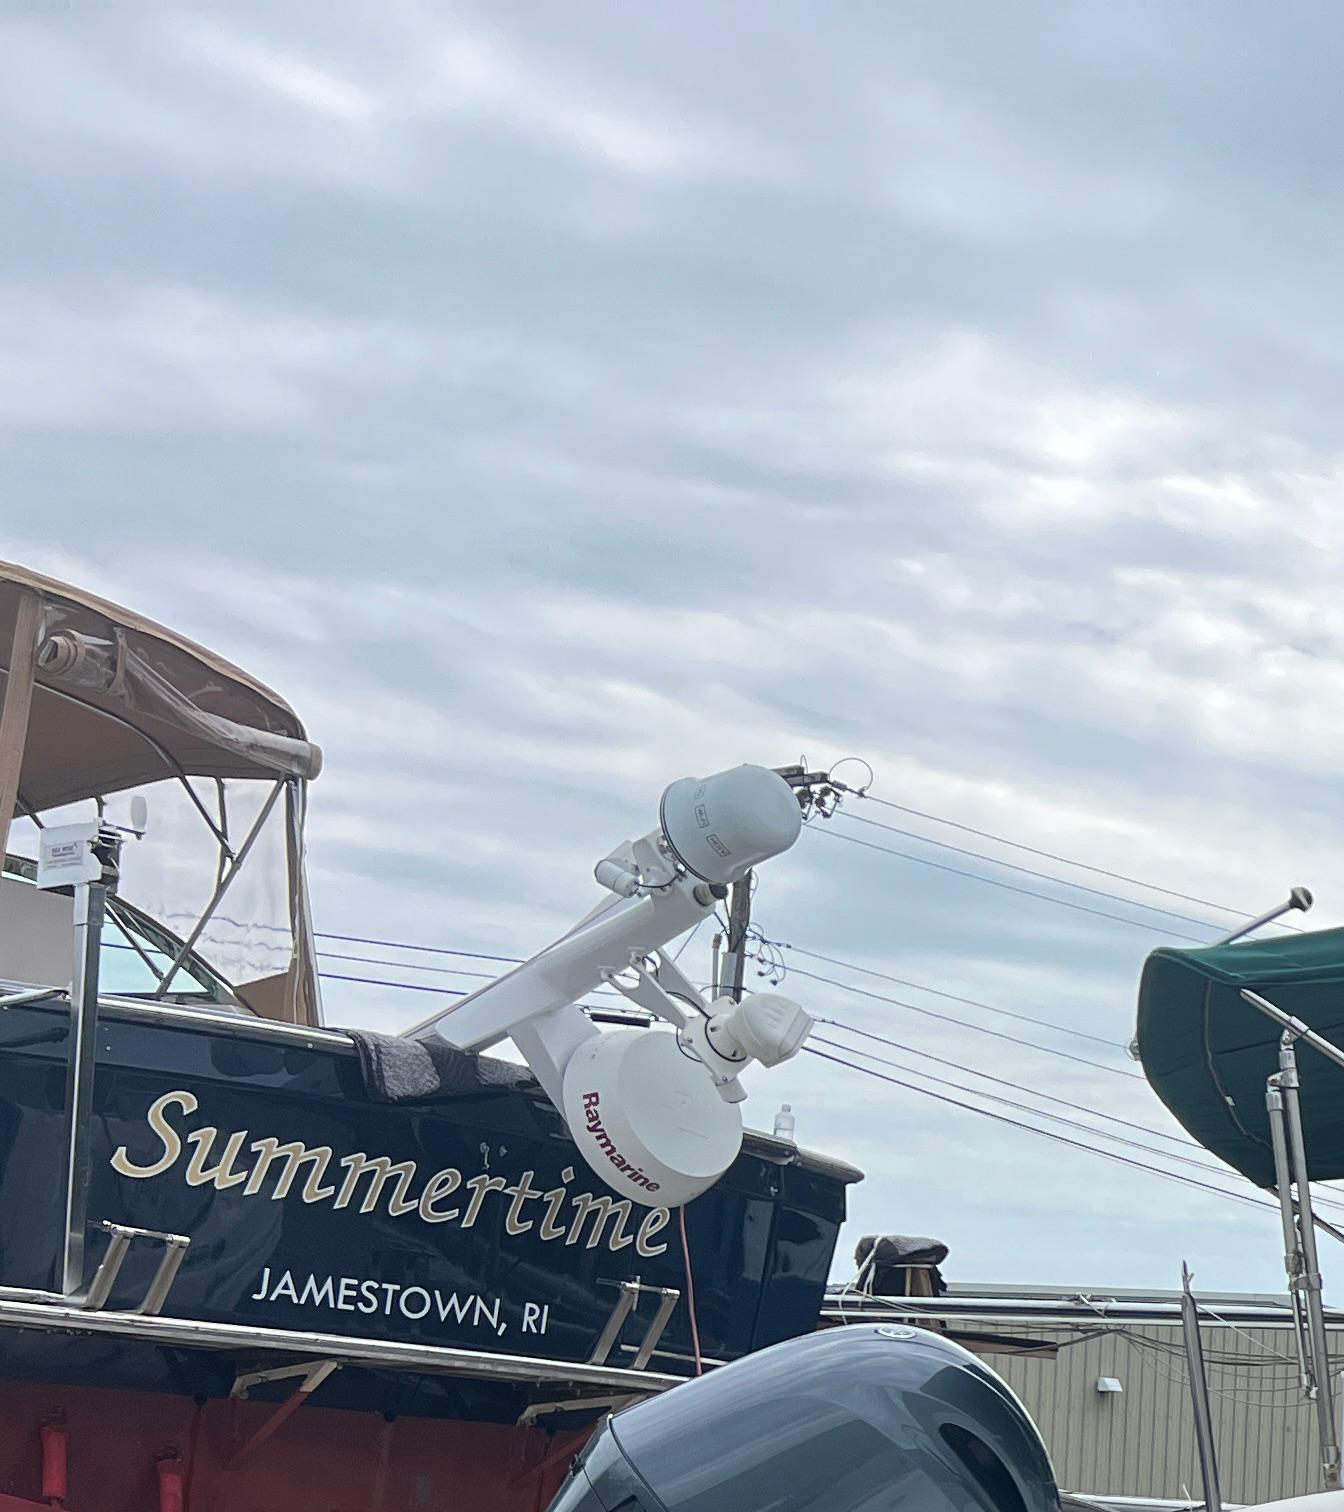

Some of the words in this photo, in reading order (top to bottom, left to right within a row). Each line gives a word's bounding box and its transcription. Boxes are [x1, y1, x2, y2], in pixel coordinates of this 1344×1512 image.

[109, 1090, 671, 1258] Summertime
[582, 1091, 661, 1192] Raymarine
[251, 1267, 507, 1336] JAMESTOWN,
[521, 1302, 549, 1334] RI
